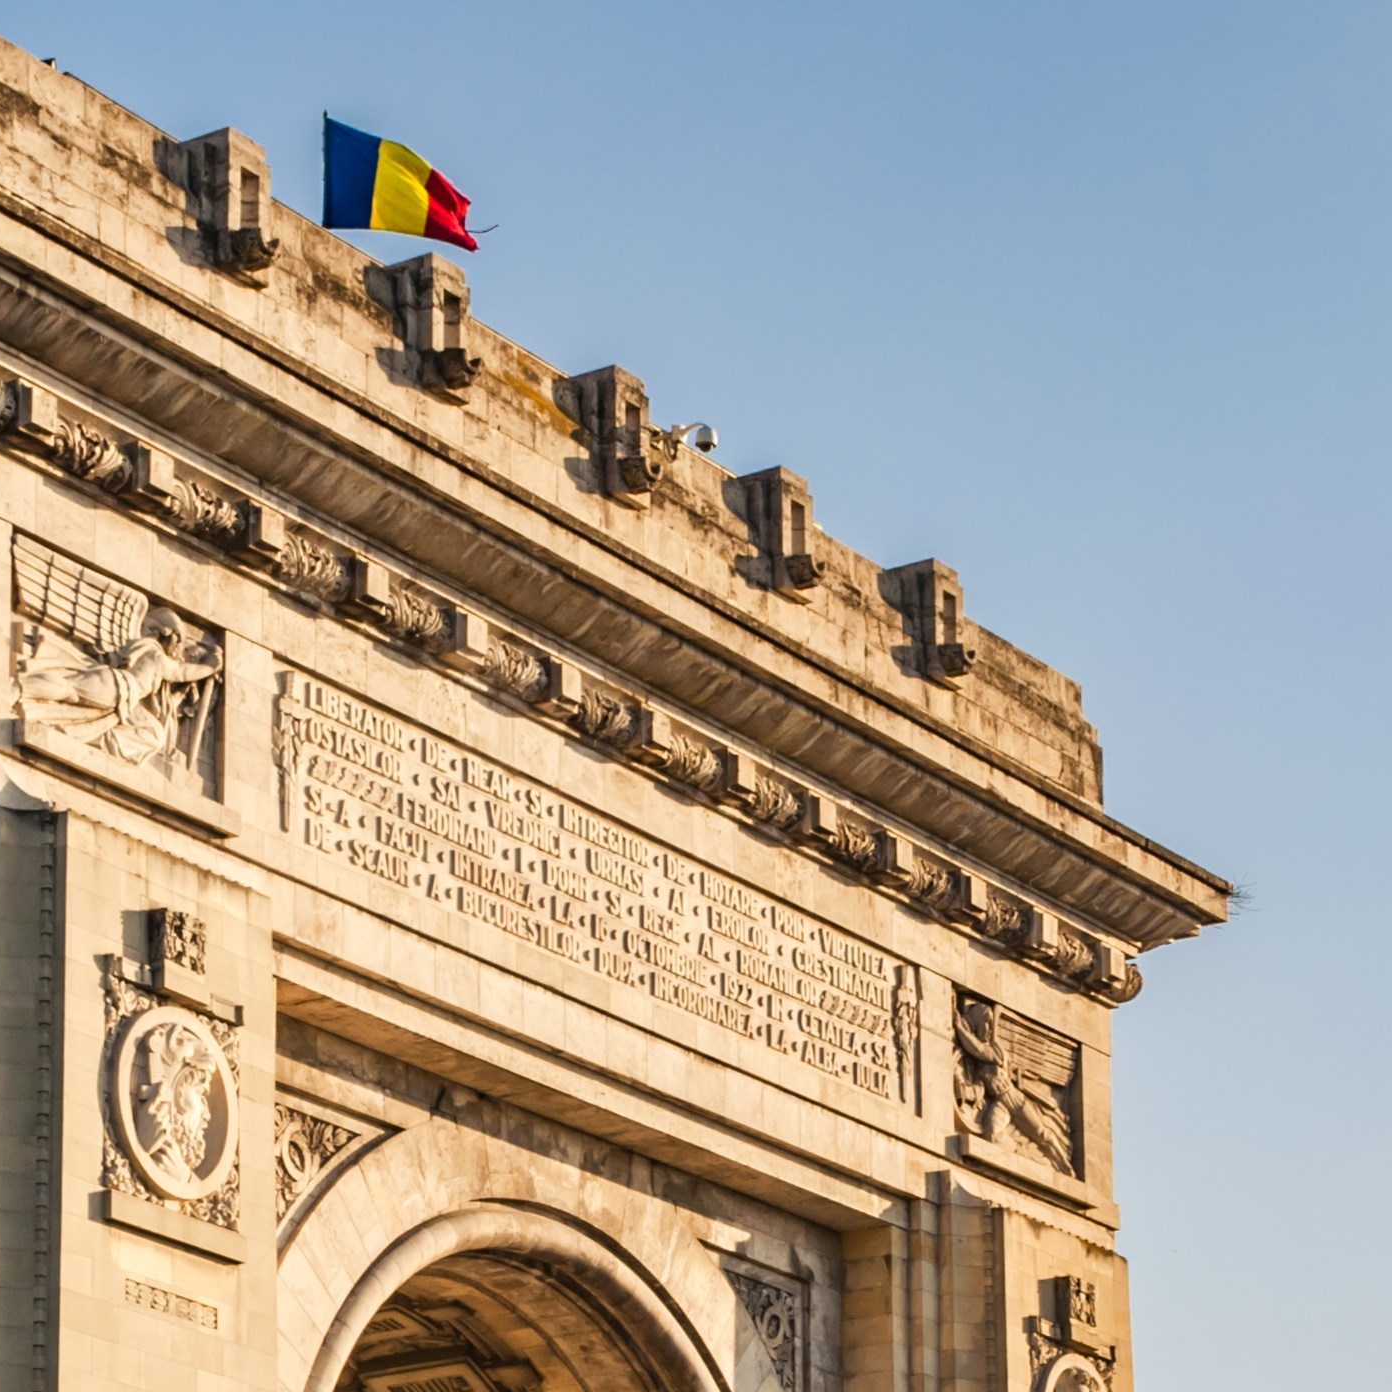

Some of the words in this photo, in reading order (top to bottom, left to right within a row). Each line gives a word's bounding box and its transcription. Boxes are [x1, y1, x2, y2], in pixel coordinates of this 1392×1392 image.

[305, 818, 331, 854] DE
[350, 839, 409, 888] SCAUN
[427, 874, 442, 902] A
[458, 887, 581, 963] BUCURESTILOR
[595, 948, 637, 988] DUPA
[650, 972, 756, 1040] INCORONAREA
[767, 1023, 789, 1056] LA
[307, 683, 405, 752] LIBERATOR
[422, 738, 447, 773] DE
[464, 758, 512, 803] NEAM
[560, 804, 650, 869] INTREGITOR
[664, 854, 686, 886] DE
[700, 872, 758, 922] HOTARE
[772, 906, 806, 944] PRIN
[819, 928, 889, 982] VIRTUTEA
[308, 717, 403, 785] OSTASILOR
[432, 777, 461, 812] SAI
[486, 801, 561, 858] VREDNICI
[587, 849, 645, 898] URMASI
[669, 889, 685, 917] AI
[708, 906, 770, 957] EROILOR
[793, 947, 890, 1012] CRESTINATATII
[377, 816, 429, 863] FACUT
[451, 850, 537, 912] INTRAREA
[551, 896, 575, 929] LA
[591, 914, 609, 942] 16
[623, 930, 707, 989] OCTOMBRIE
[720, 973, 754, 1009] 1922
[767, 994, 784, 1023] IN
[797, 1009, 861, 1058] CETATEA
[871, 1042, 891, 1071] SA
[398, 793, 496, 860] FERDINAND
[516, 847, 523, 874] I
[542, 860, 588, 903] DOMN
[640, 905, 680, 946] REGE
[699, 933, 719, 964] AL
[737, 950, 817, 1009] ROMANILOR
